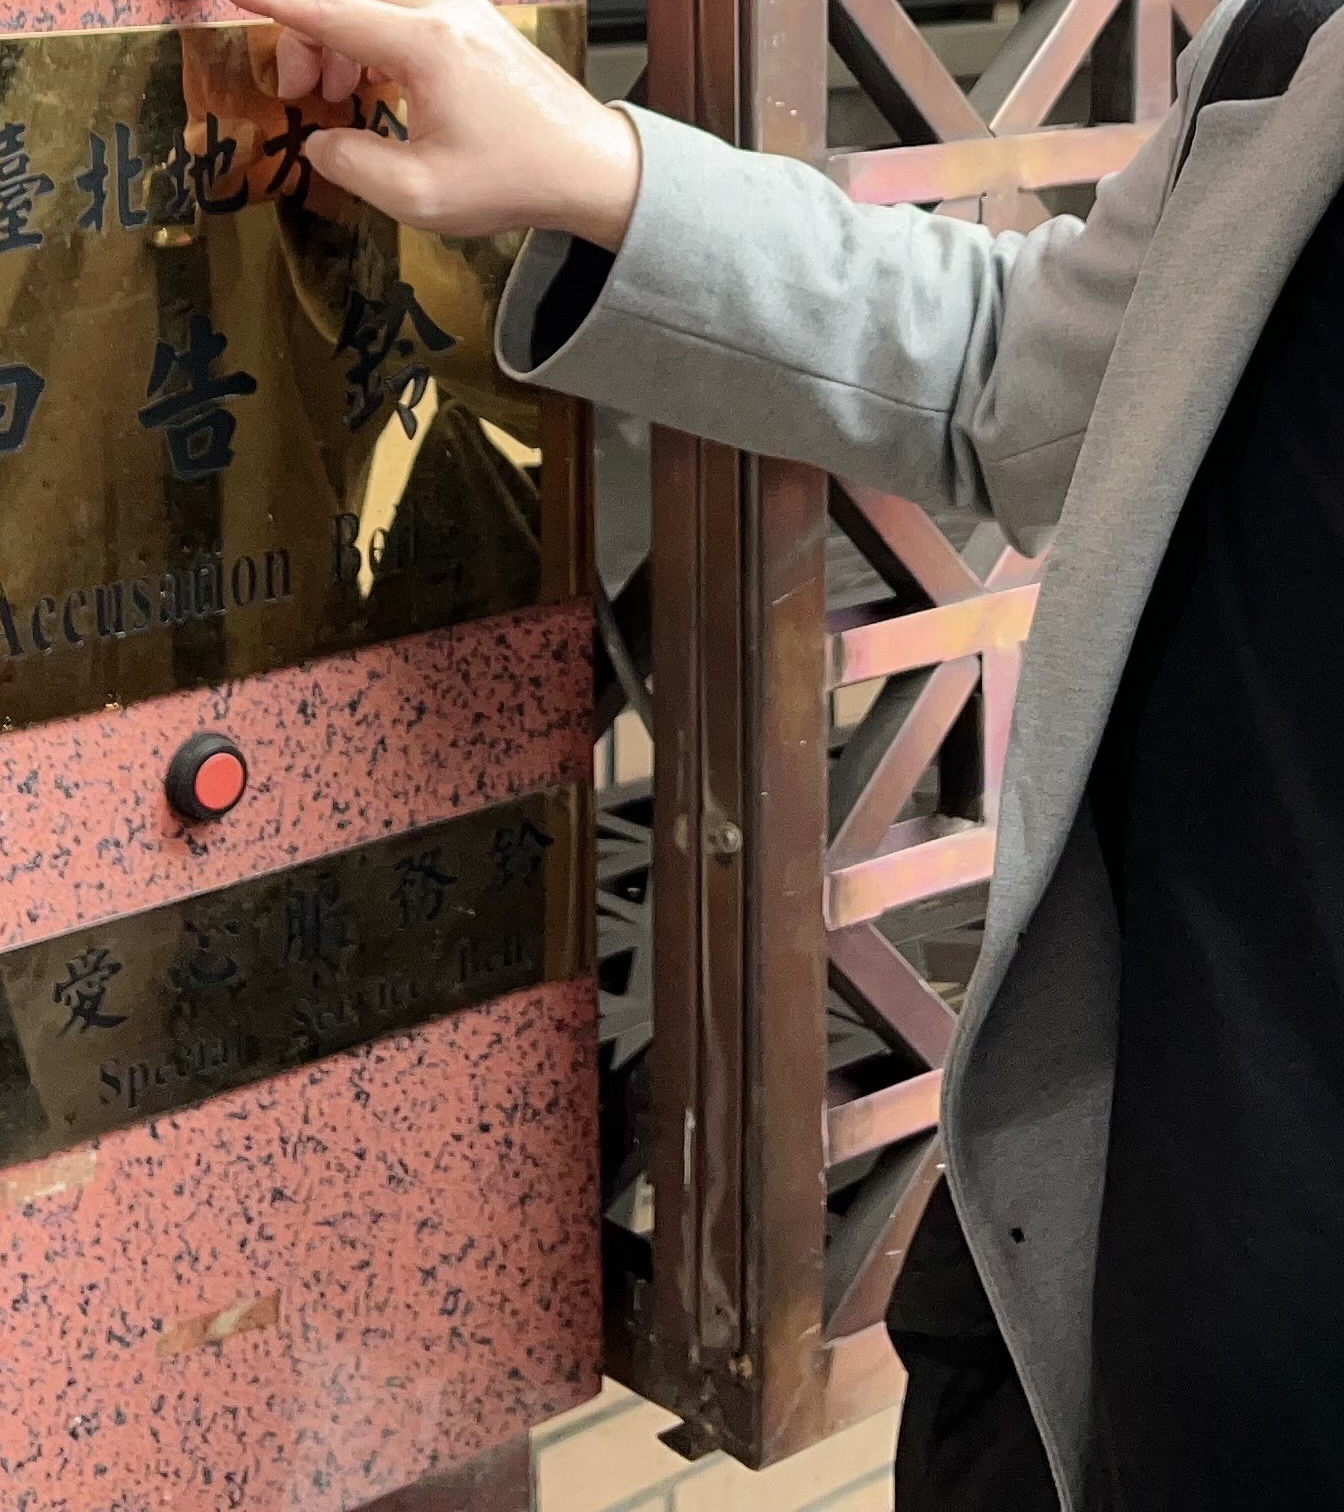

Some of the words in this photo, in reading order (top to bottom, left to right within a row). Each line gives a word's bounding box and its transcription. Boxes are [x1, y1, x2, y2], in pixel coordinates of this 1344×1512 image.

[53, 819, 554, 1038] 愛心服務鈴
